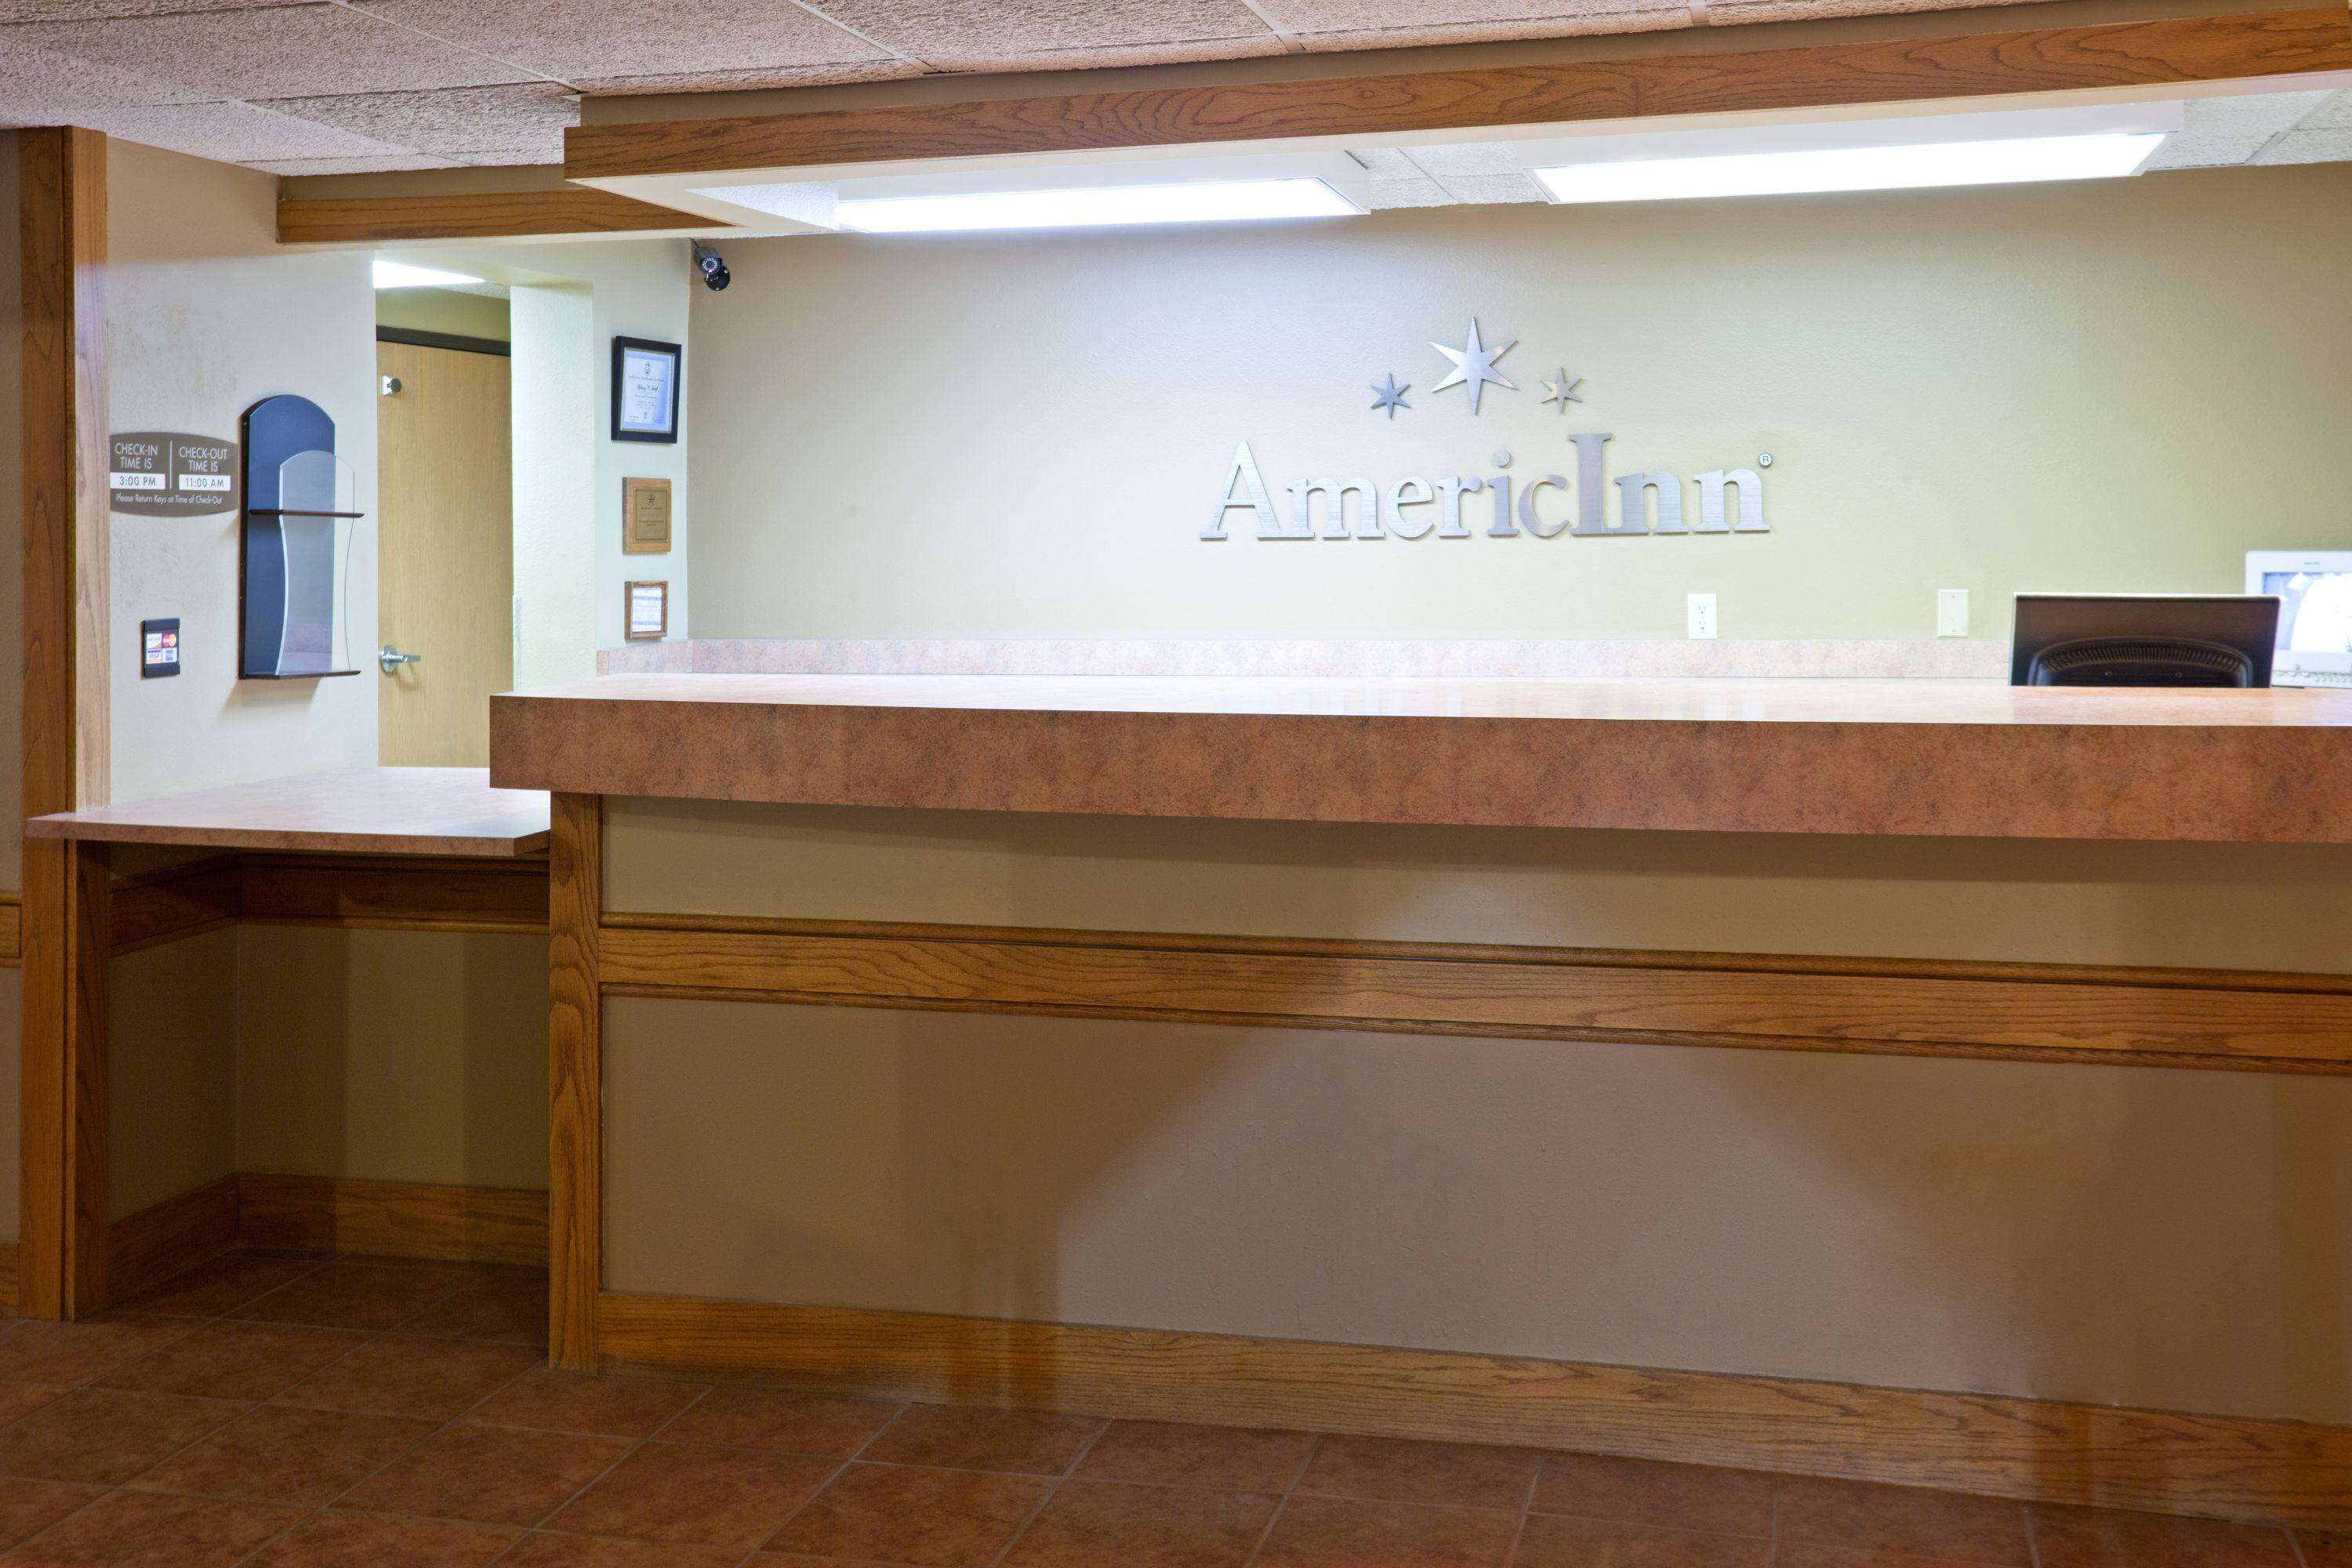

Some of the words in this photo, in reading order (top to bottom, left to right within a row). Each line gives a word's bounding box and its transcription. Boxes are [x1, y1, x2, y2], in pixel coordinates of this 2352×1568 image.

[114, 443, 158, 456] CHECK-IN
[179, 446, 228, 460] CHECK-OUT
[120, 456, 141, 469] TIME
[144, 457, 152, 470] IS
[188, 459, 208, 471] TIME
[211, 460, 219, 472] IS
[119, 476, 140, 486] 3:00
[143, 477, 156, 486] PM
[185, 477, 207, 487] 11:00
[210, 477, 224, 488] AM
[116, 493, 134, 503] Please
[135, 494, 153, 503] Return
[154, 495, 167, 505] Keys
[175, 495, 188, 503] Time
[195, 495, 223, 504] Check-Out
